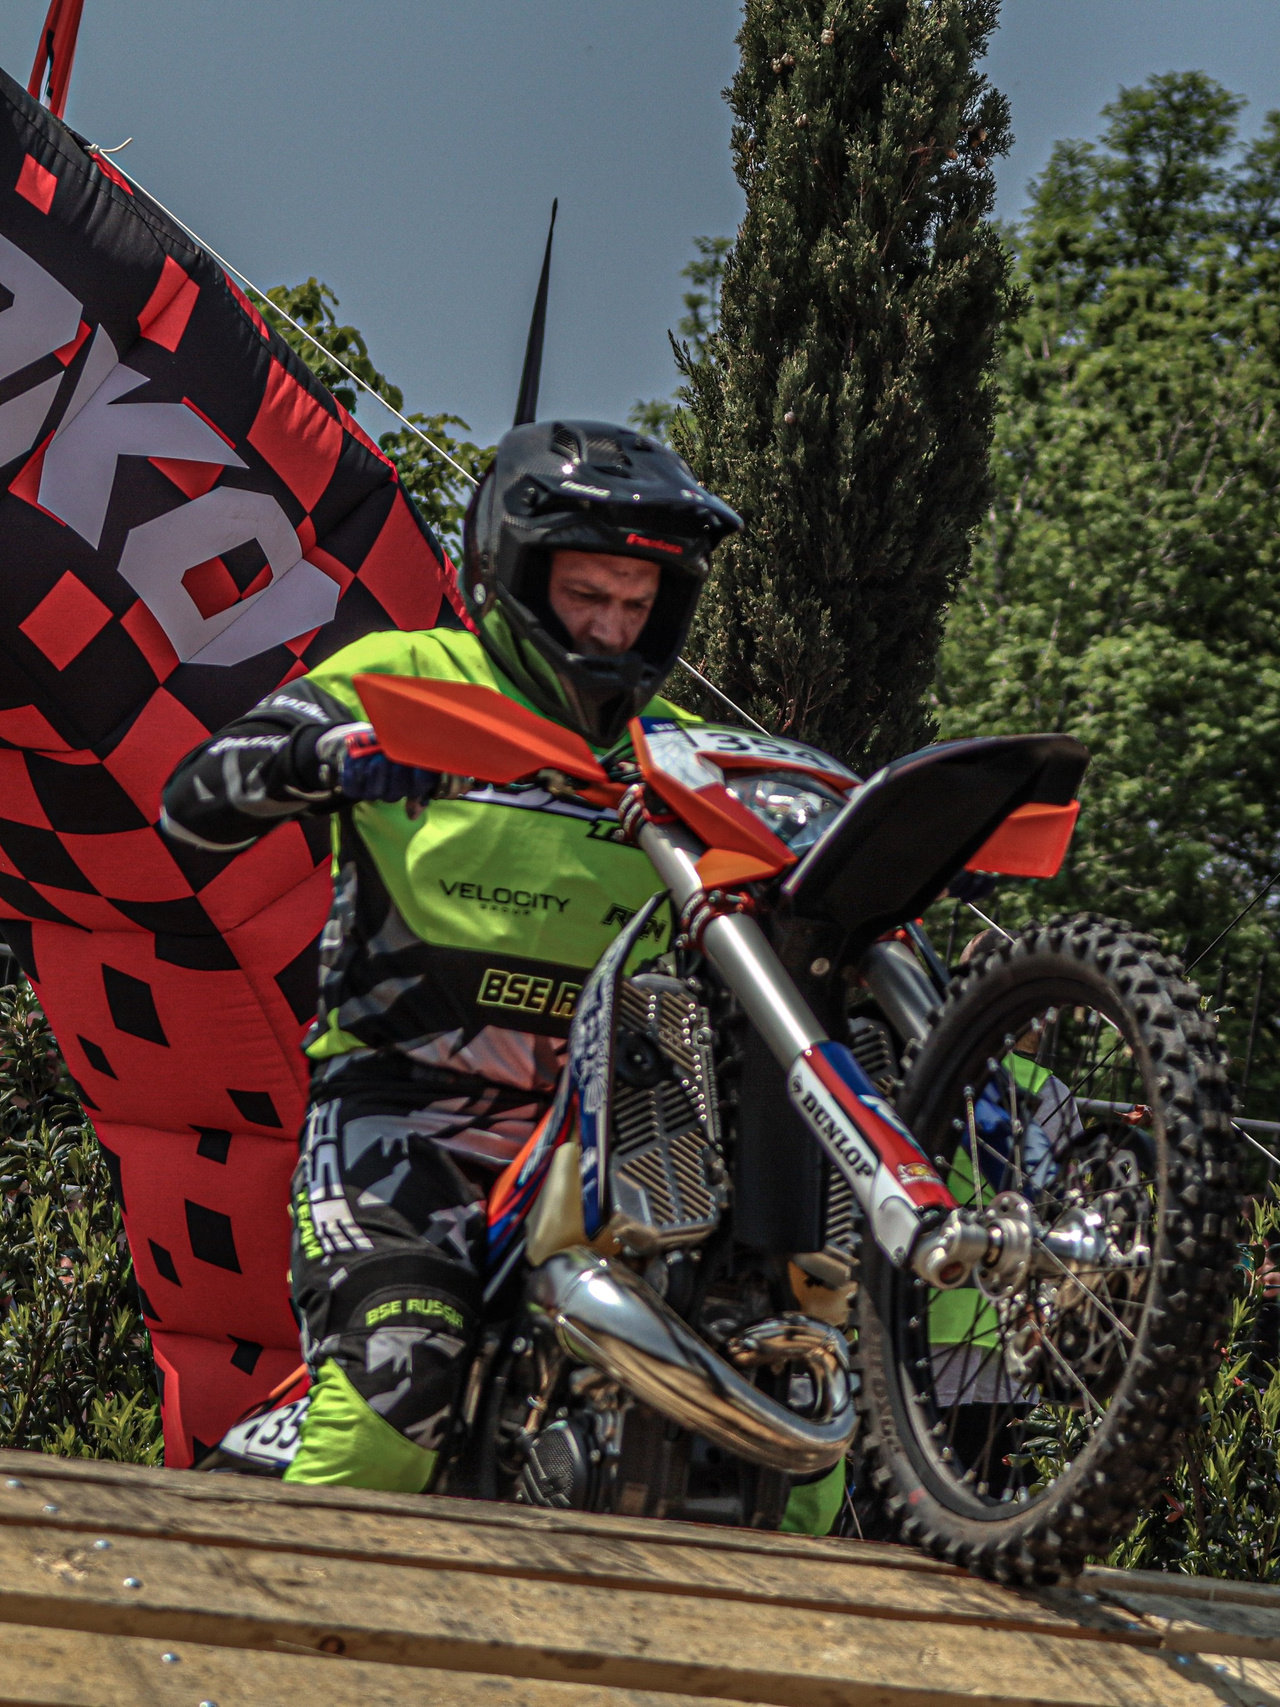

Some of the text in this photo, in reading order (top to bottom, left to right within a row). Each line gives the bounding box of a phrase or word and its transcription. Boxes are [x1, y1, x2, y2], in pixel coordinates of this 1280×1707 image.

[439, 879, 571, 913] VELOCITY
[477, 968, 554, 1014] BSE
[802, 1090, 874, 1176] DUNLOP
[297, 1190, 324, 1260] TEAM
[365, 1300, 403, 1327] BSE
